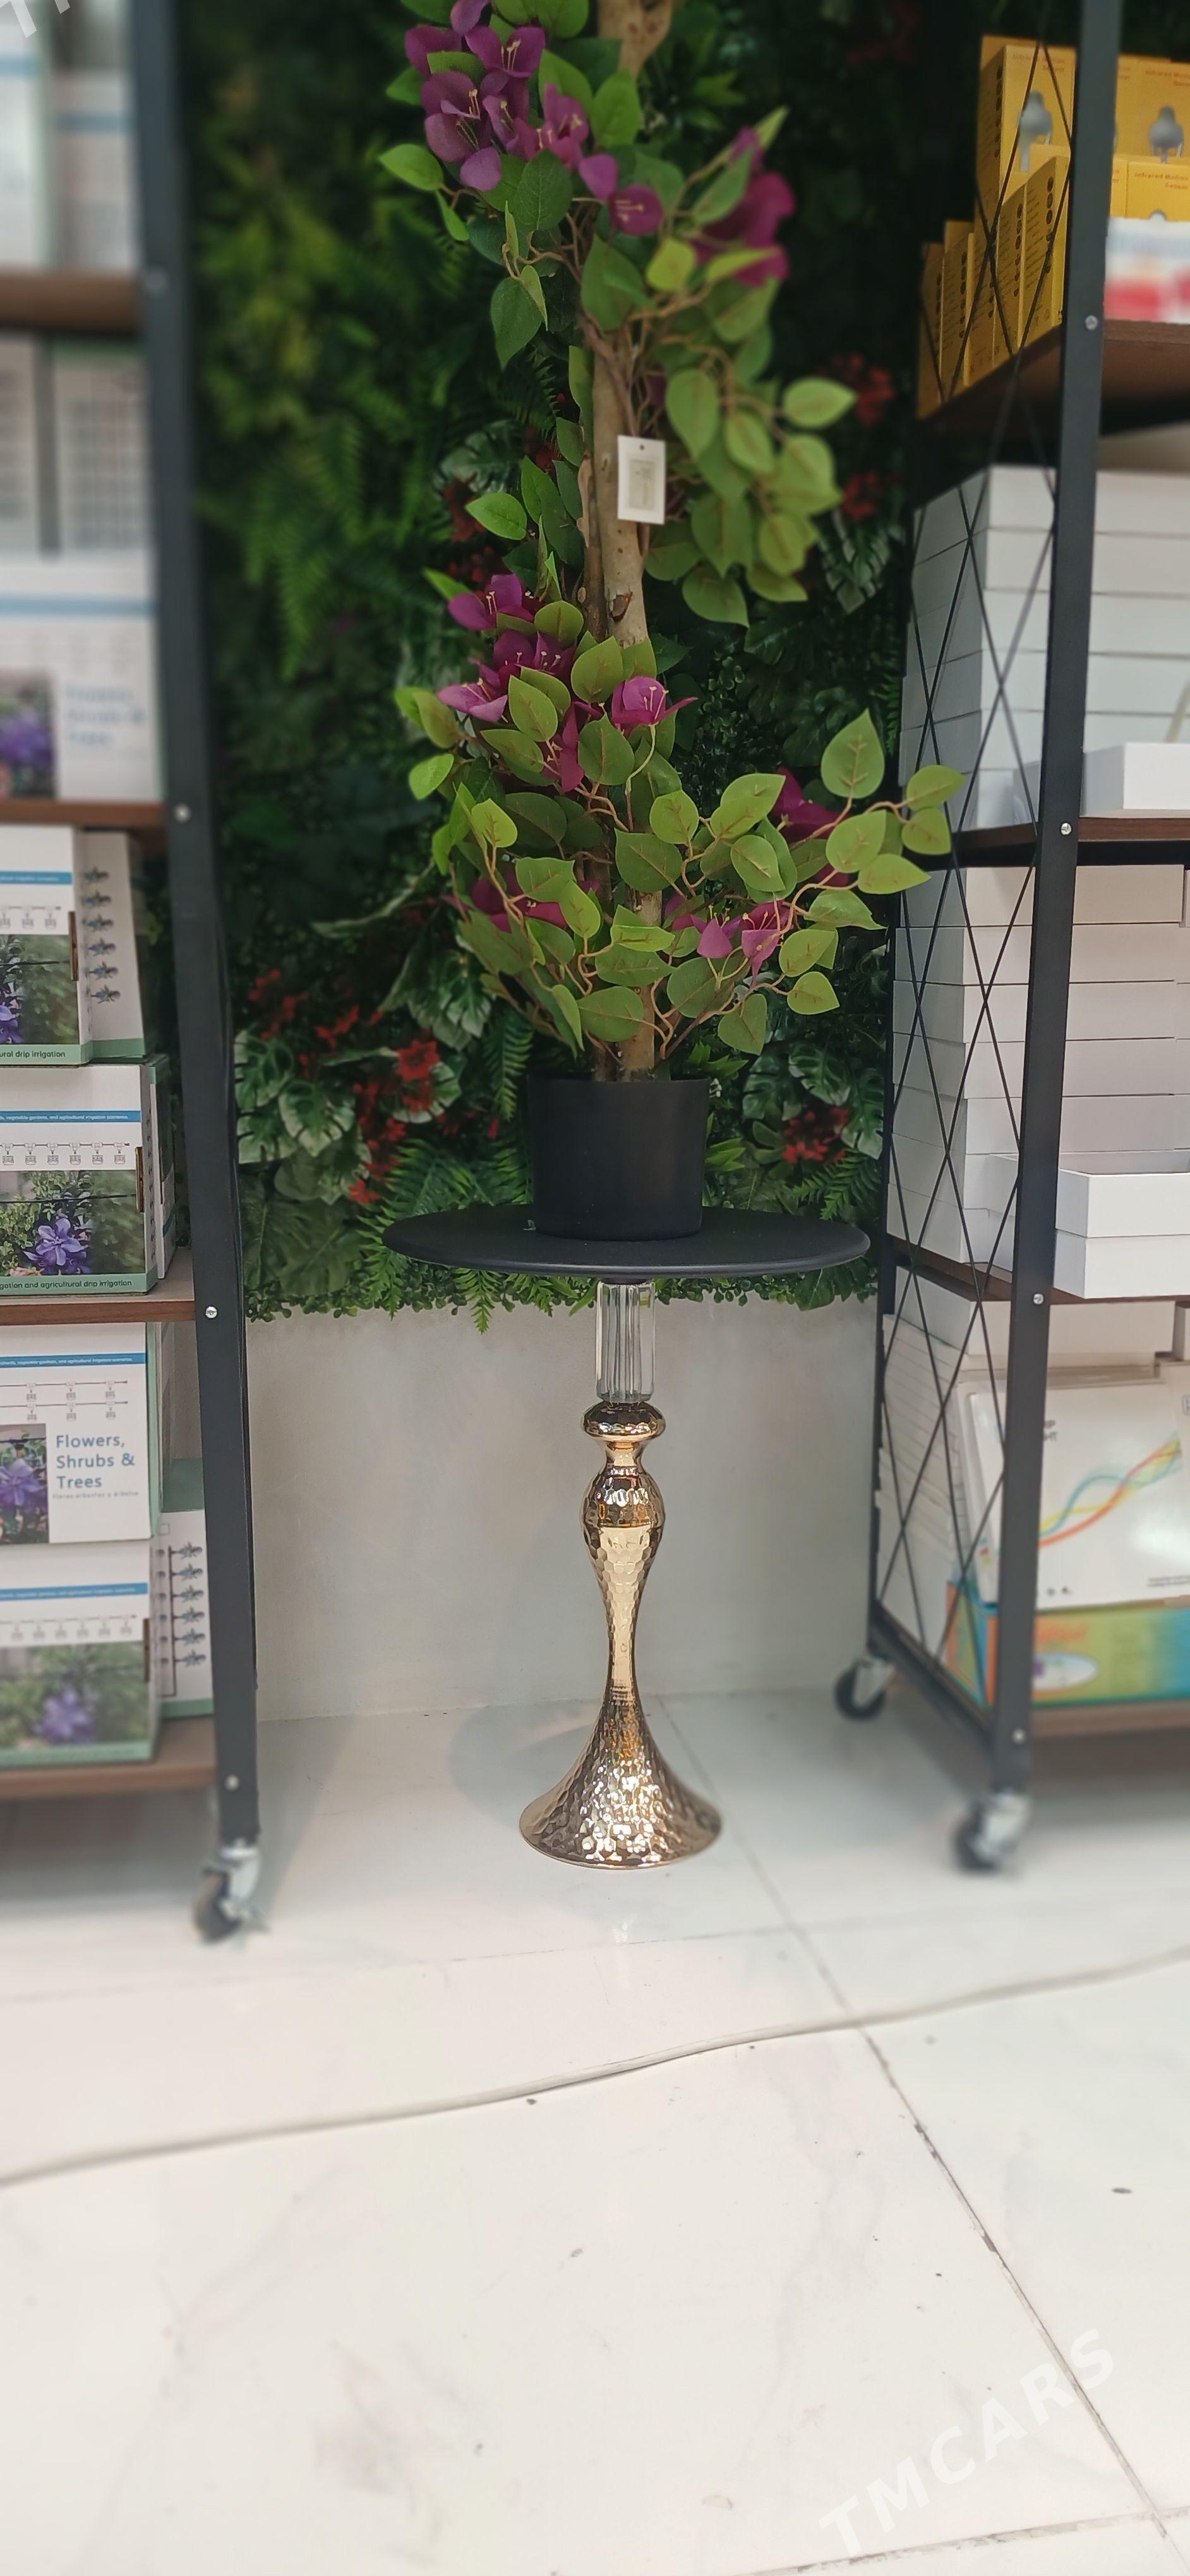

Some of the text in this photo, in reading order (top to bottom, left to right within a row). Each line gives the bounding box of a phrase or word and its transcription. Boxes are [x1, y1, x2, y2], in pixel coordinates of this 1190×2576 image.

[32, 1051, 66, 1059] irrigation
[40, 1280, 82, 1289] agricultural
[99, 1279, 132, 1288] irrigation
[56, 1434, 125, 1448] Flowers,
[56, 1453, 136, 1469] Shrubs &
[56, 1475, 102, 1489] Trees
